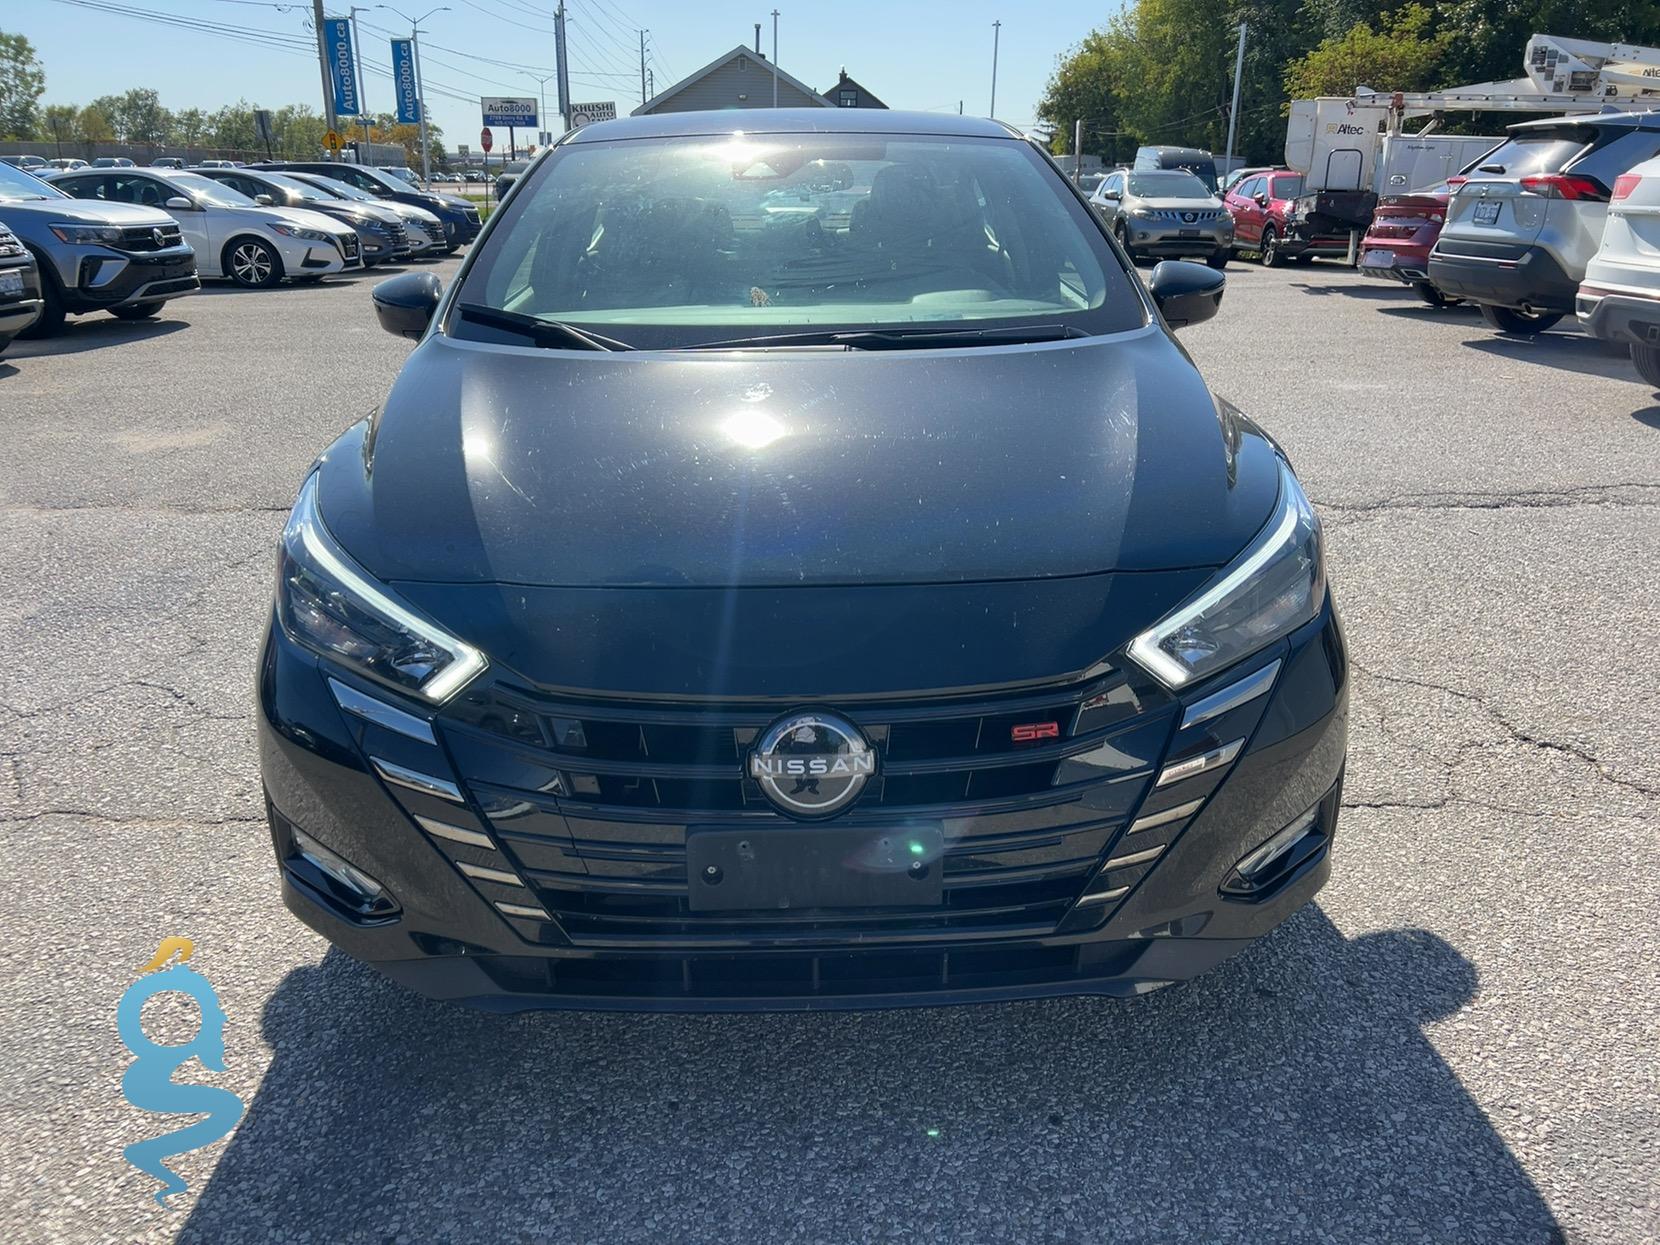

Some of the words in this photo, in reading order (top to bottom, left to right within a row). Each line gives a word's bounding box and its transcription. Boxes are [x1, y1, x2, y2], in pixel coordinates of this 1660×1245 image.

[336, 22, 354, 110] Auto8000.ca
[400, 43, 414, 120] Auto8000.ca
[488, 104, 531, 113] Auto8000
[572, 103, 613, 113] KHUSHI
[1337, 123, 1364, 135] Altec
[1012, 722, 1059, 741] SR
[754, 755, 871, 774] NISSAN
